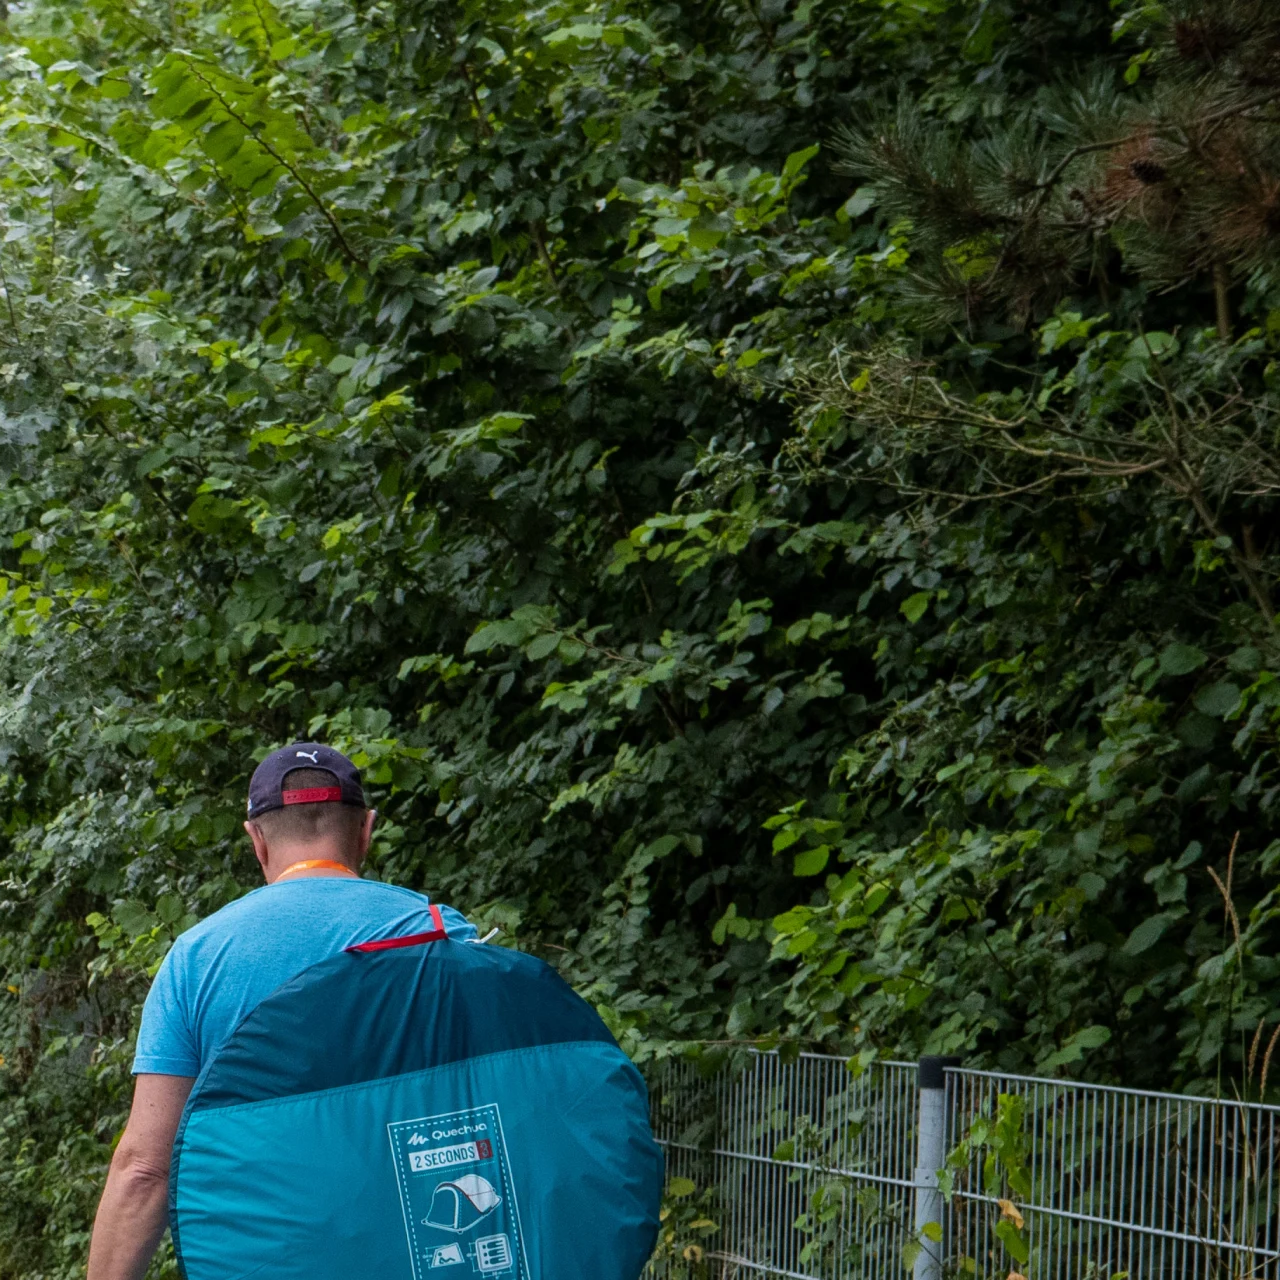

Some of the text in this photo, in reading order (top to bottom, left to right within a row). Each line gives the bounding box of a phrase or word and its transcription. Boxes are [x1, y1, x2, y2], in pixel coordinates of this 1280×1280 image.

[431, 1123, 487, 1140] Quechua
[414, 1142, 489, 1169] 2 SECONDS 3
